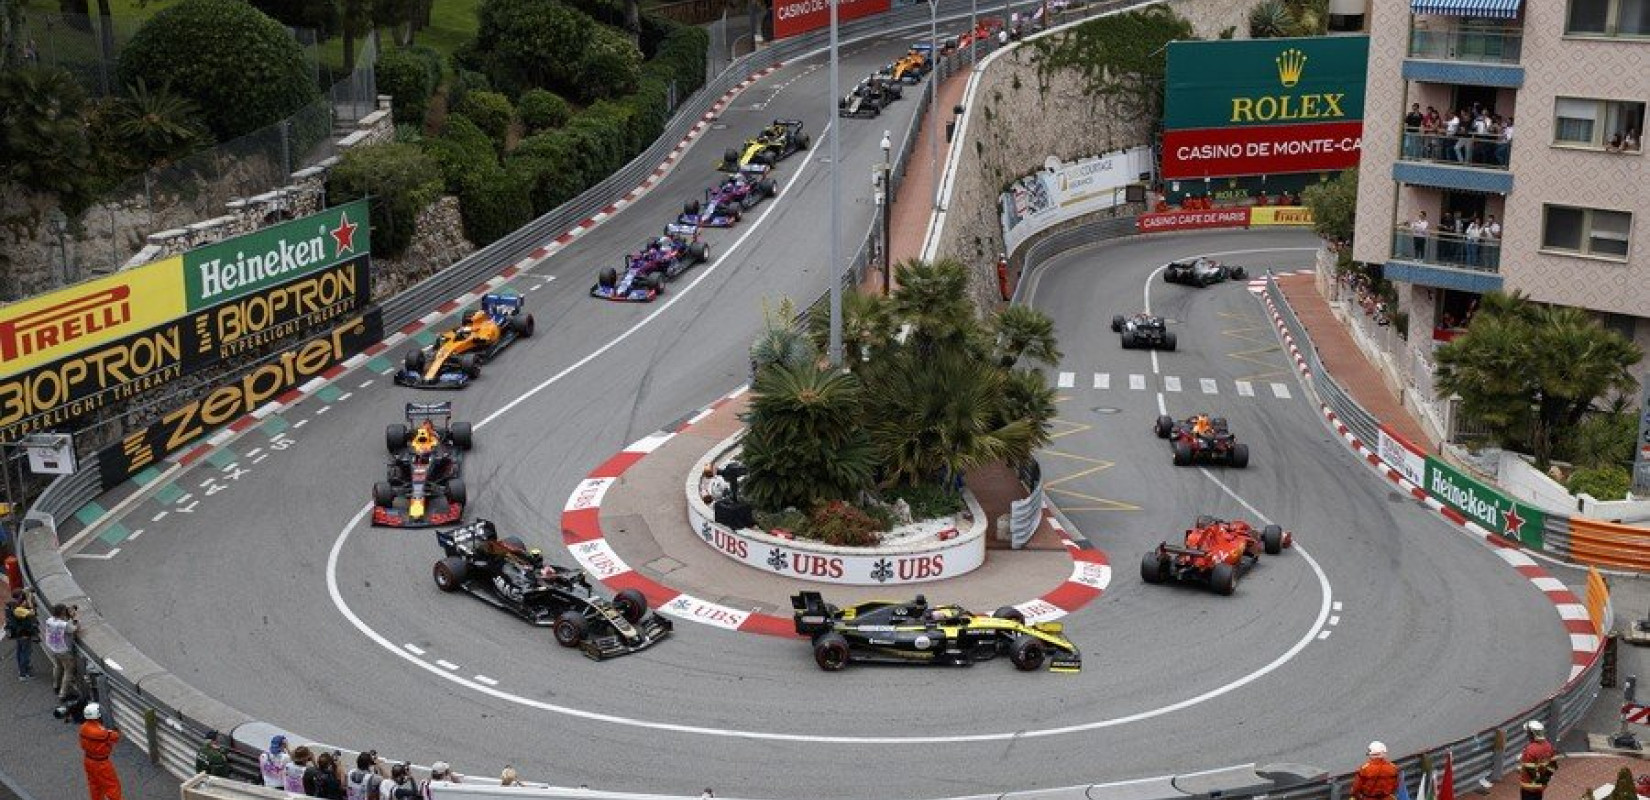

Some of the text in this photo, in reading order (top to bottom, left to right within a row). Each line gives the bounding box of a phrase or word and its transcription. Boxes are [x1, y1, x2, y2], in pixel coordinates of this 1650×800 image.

[1231, 93, 1345, 122] ROLEX
[1176, 137, 1362, 161] CASINO DE MONTE-CA
[1143, 217, 1177, 228] CASINO
[1204, 214, 1217, 223] DE
[1218, 212, 1246, 223] PARIS
[200, 236, 326, 299] Heineken
[0, 284, 130, 362] PIRELLI
[217, 263, 355, 342] BIOPTRON
[220, 301, 355, 359] HYPERLIGHT THERAPY
[0, 326, 181, 427] BIOPTRON
[114, 362, 182, 398] THERAPY
[163, 316, 363, 451] zepter
[1431, 467, 1497, 527] Heineken
[588, 550, 621, 576] UBS
[715, 530, 943, 580] UBS UBS UBS
[694, 604, 743, 626] UBS
